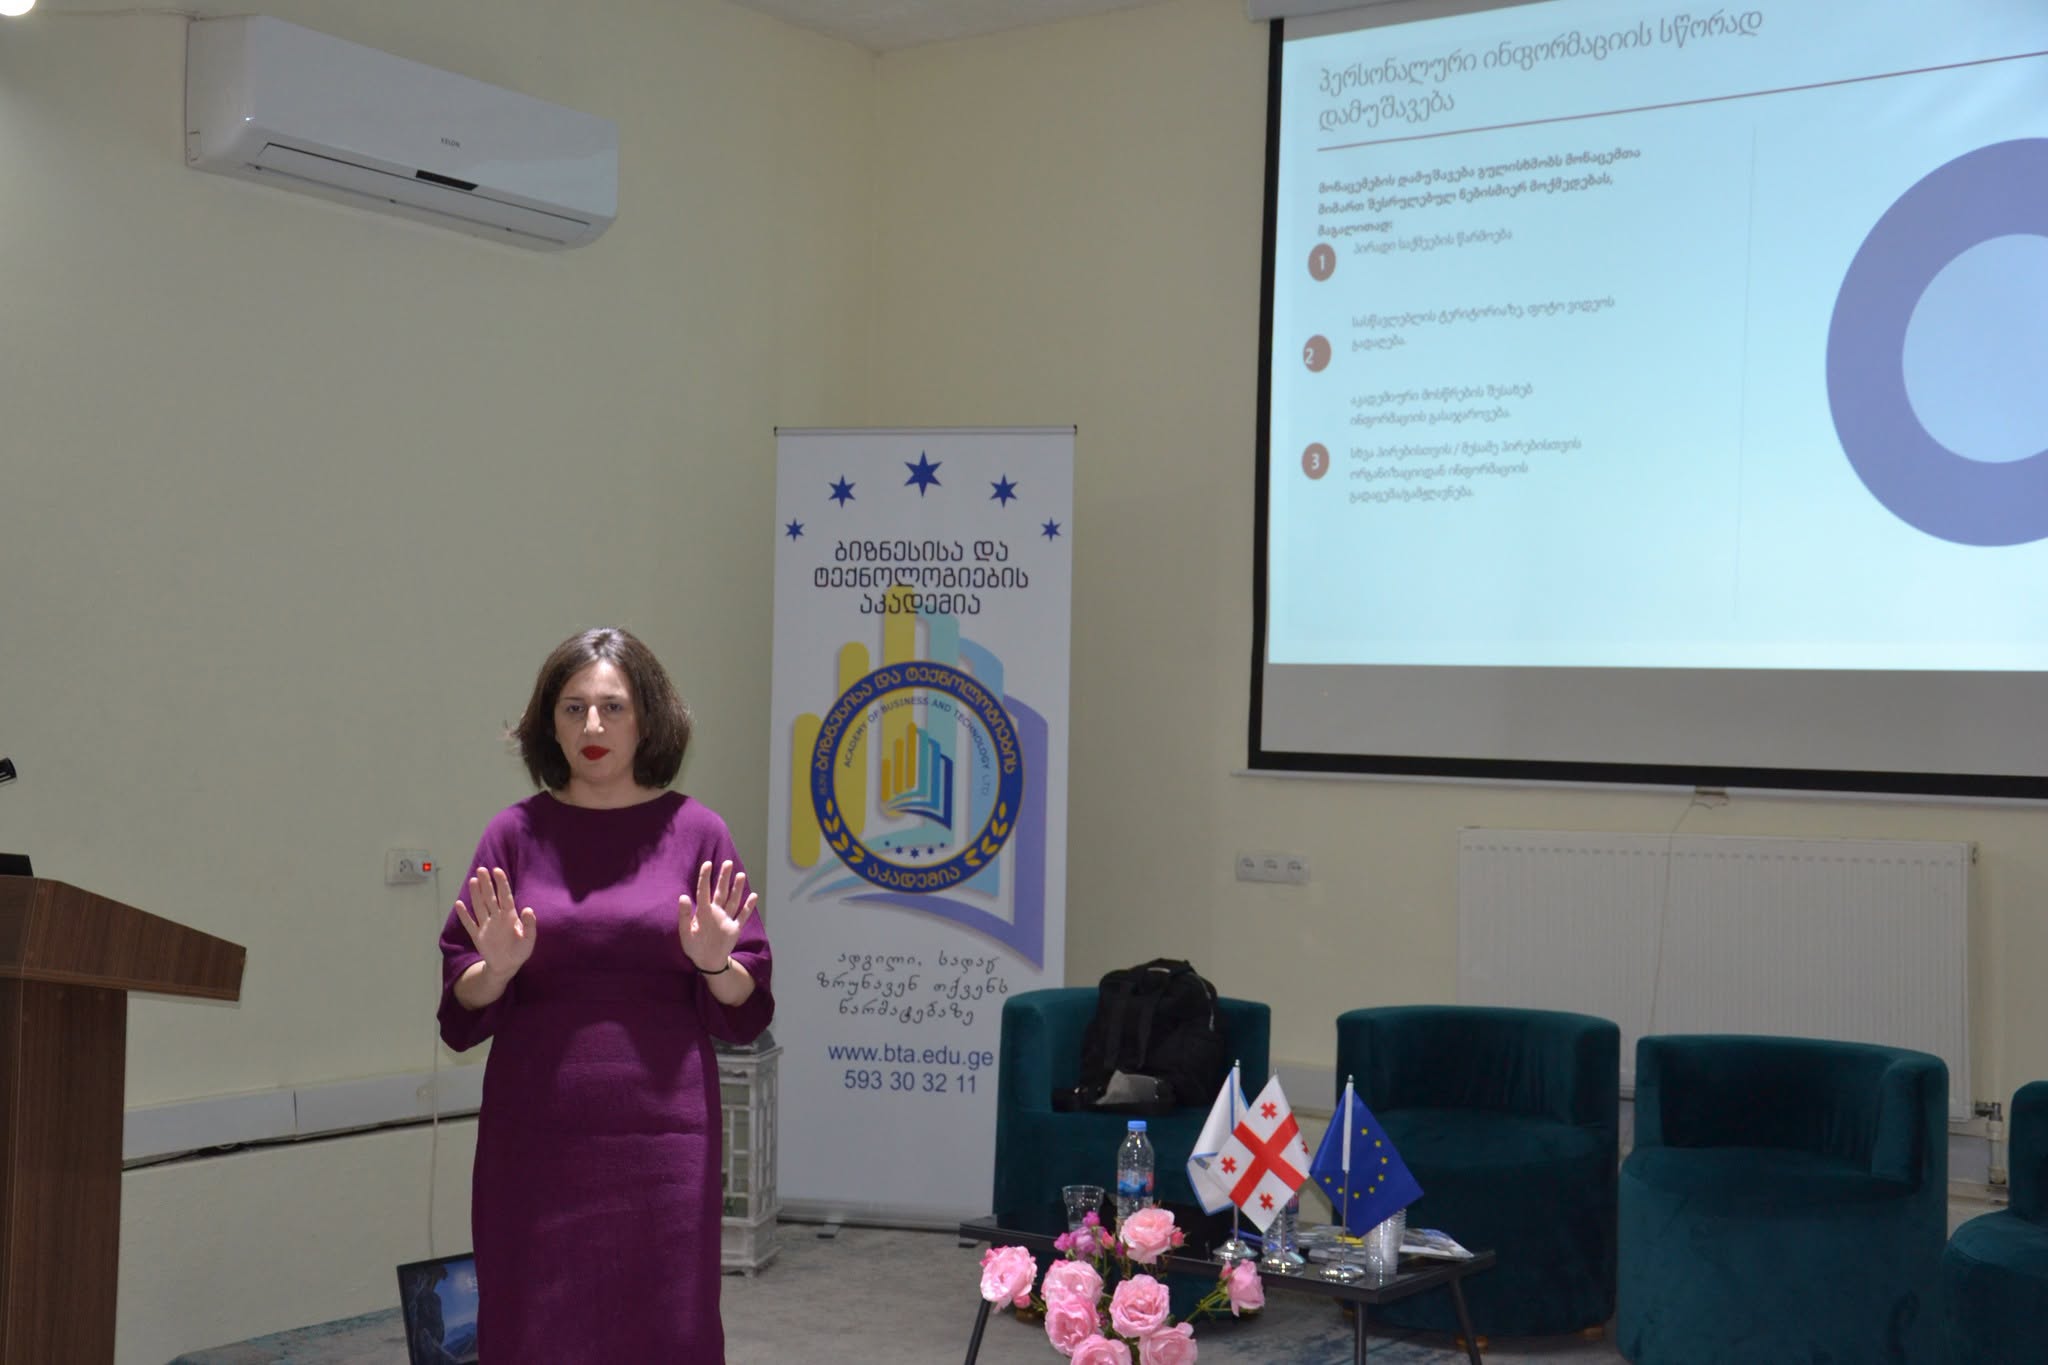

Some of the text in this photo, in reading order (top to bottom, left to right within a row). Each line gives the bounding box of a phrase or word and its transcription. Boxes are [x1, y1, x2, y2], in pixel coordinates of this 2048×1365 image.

[1320, 9, 1763, 98] პერსონალური ინფორმაციის სწორად
[1318, 91, 1455, 132] დამუშავება
[1319, 148, 1641, 194] მონაცემების დამუშავება გულისხმობს მონაცემთა
[1318, 201, 1364, 215] მიმართ
[1459, 181, 1527, 203] ნებისმიერ
[1318, 255, 1325, 271] 1
[1304, 347, 1314, 365] 2
[1311, 453, 1320, 469] 3
[834, 541, 1009, 562] ბიზნესისა და
[814, 567, 1029, 589] ტექნოლოგიების
[860, 593, 981, 615] აკადემია
[874, 669, 901, 689] და
[843, 723, 868, 769] ACADEMY
[867, 709, 880, 723] OF
[881, 696, 929, 714] BUSINESS
[931, 697, 951, 713] AND
[953, 710, 991, 769] TECHNOLOGY
[867, 862, 961, 888] აკადემია
[817, 971, 1008, 1001] ზრუნავენ თქვენს
[828, 1043, 993, 1071] www.bta.edu.ge
[844, 1069, 976, 1094] 593 30 32 11
